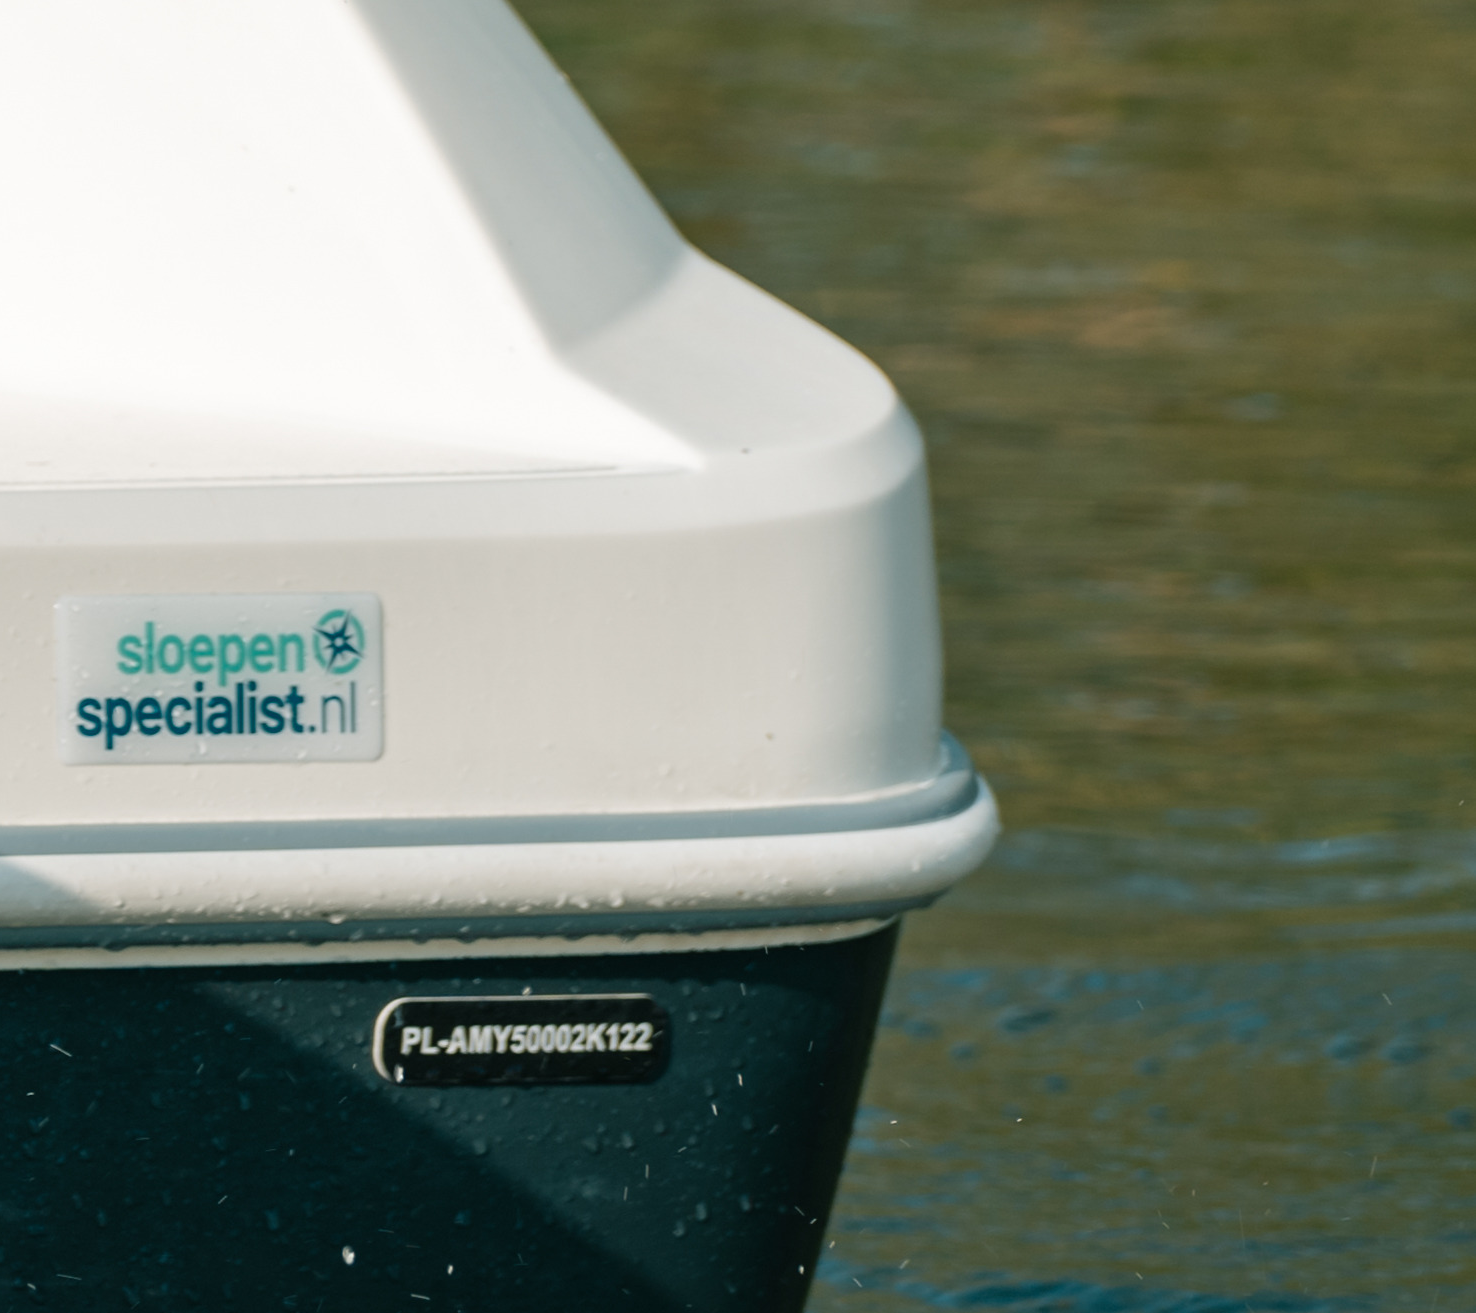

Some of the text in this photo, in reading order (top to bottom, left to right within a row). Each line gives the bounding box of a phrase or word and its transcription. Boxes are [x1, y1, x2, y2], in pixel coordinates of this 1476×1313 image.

[117, 621, 306, 687] sloepen
[76, 680, 357, 750] specialist.nl
[400, 1022, 653, 1056] PL-AMY50002K122
